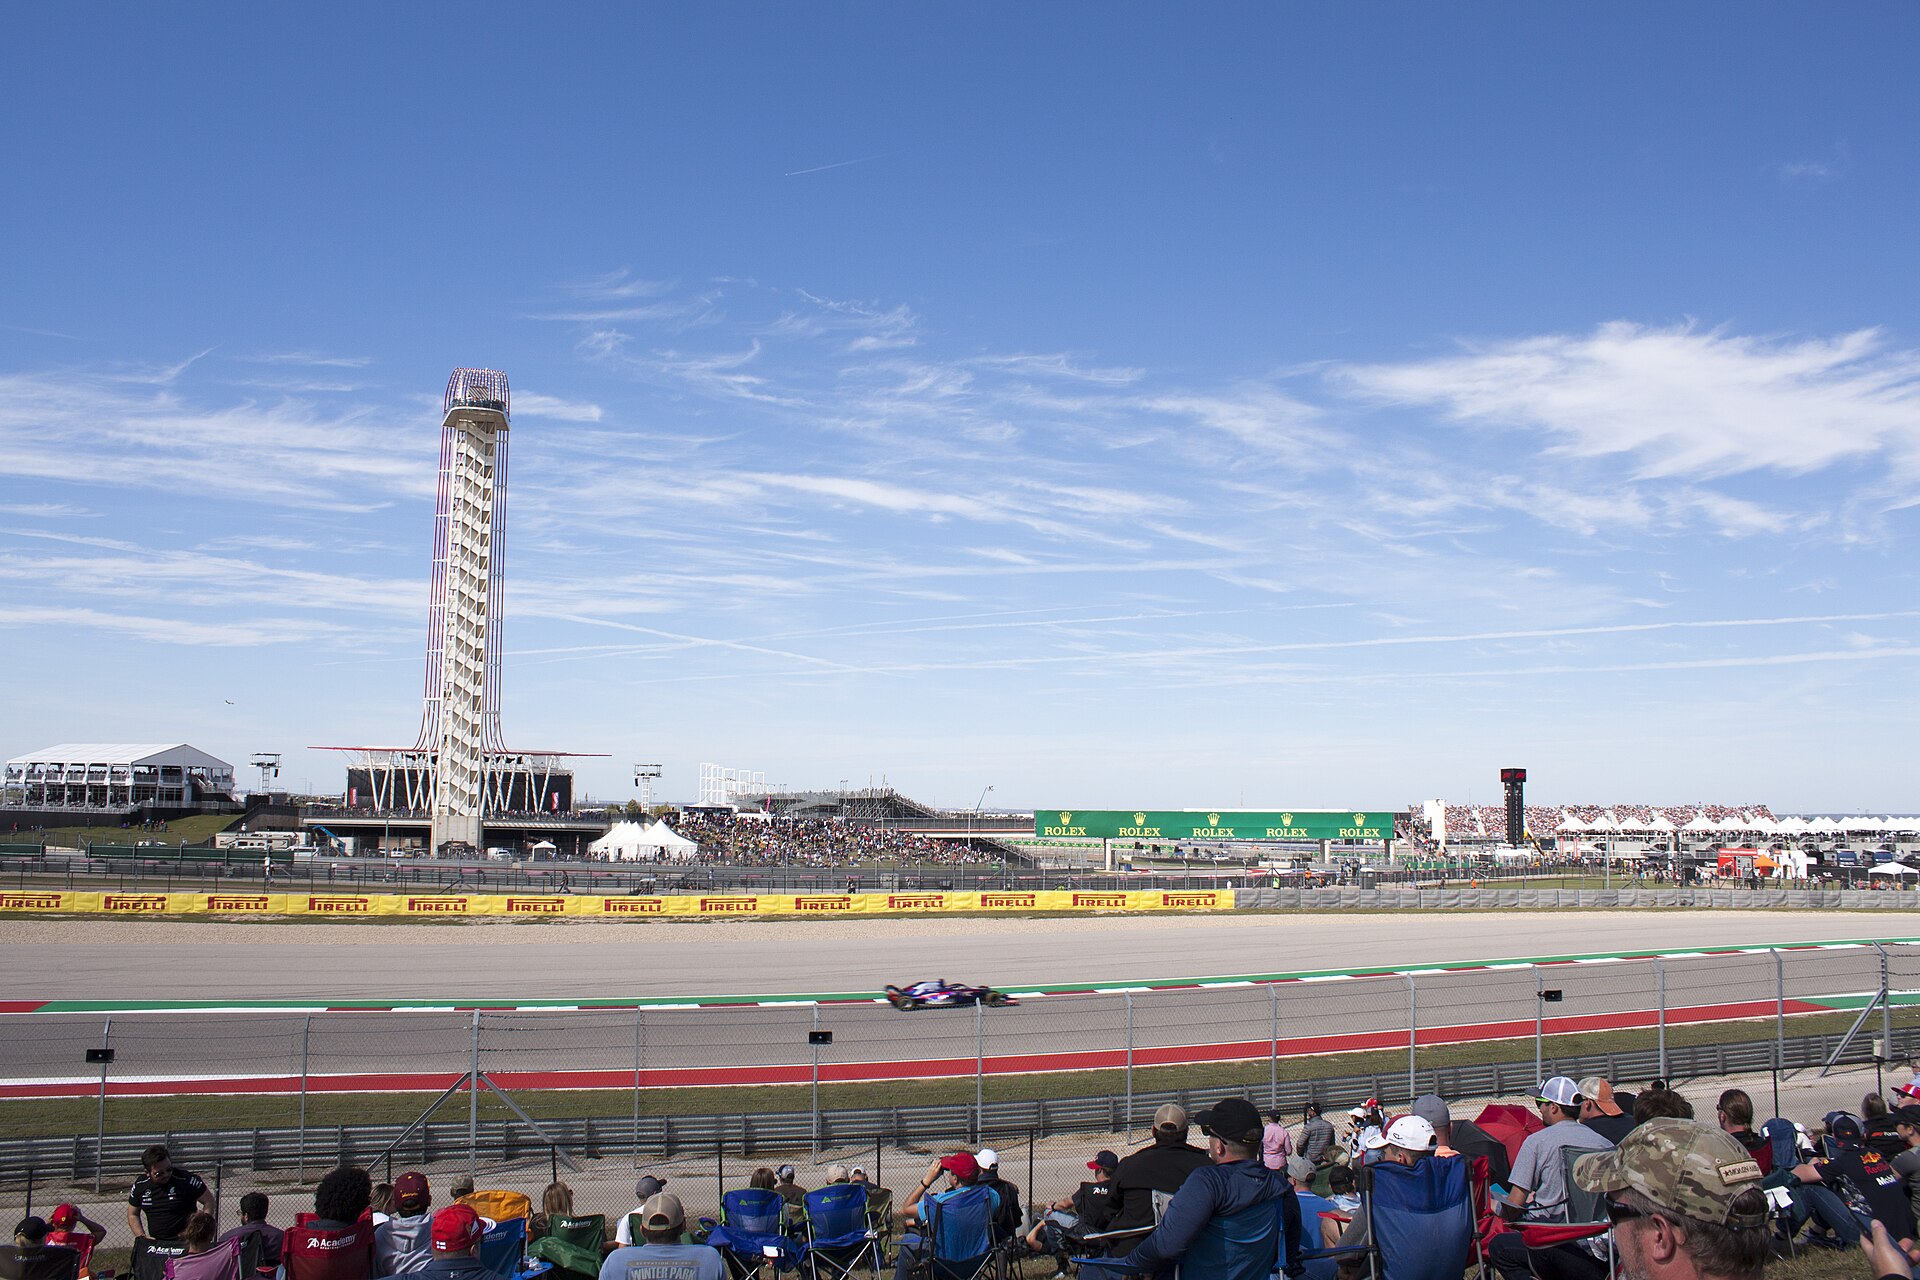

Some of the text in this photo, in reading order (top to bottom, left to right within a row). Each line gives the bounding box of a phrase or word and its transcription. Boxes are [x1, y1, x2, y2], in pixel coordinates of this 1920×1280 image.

[1044, 827, 1087, 836] ROLEX
[1118, 827, 1161, 837] ROLEX
[1192, 828, 1235, 837] ROLEX
[1266, 828, 1308, 837] ROLEX
[1339, 828, 1381, 837] ROLEX
[0, 894, 61, 908] PIRELLI
[104, 896, 166, 910] PIRELLI
[207, 896, 269, 911] PIRELLI
[309, 898, 369, 912] PIRELLI
[408, 898, 468, 912] PIRELLI
[507, 899, 565, 912] PIRELLI
[604, 899, 662, 912] PIRELLI
[700, 898, 758, 912] PIRELLI
[795, 897, 851, 911] PIRELLI
[888, 896, 944, 910] PIRELLI
[980, 894, 1036, 908] PIRELLI
[1072, 894, 1127, 907] PIRELLI
[1162, 893, 1217, 907] PIRELLI
[320, 1233, 357, 1247] Academy
[631, 1266, 696, 1280] WINTER PARK
